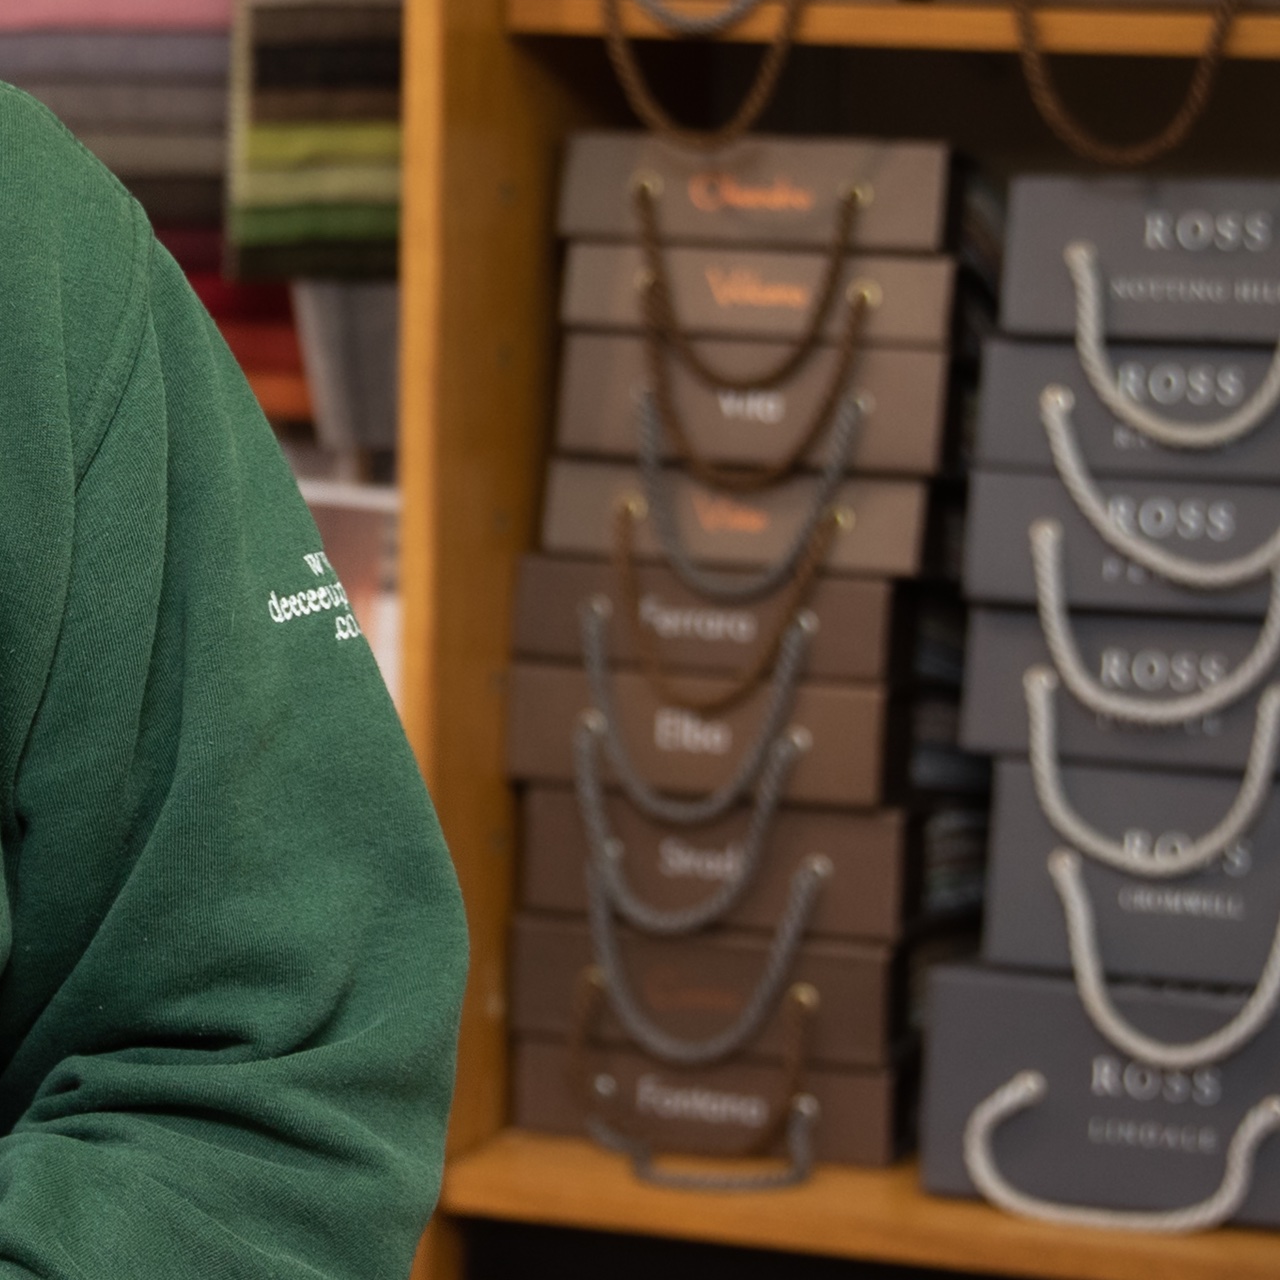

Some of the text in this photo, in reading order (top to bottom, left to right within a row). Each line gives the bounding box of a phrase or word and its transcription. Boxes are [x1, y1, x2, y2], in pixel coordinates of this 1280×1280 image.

[1144, 210, 1272, 253] ROSS
[1116, 360, 1245, 408] ROSS
[1107, 494, 1237, 542] ROSS
[1100, 646, 1228, 693] ROSS
[1123, 827, 1252, 879] ROS
[1117, 886, 1246, 919] CROMWELL
[1090, 1052, 1223, 1106] ROSS
